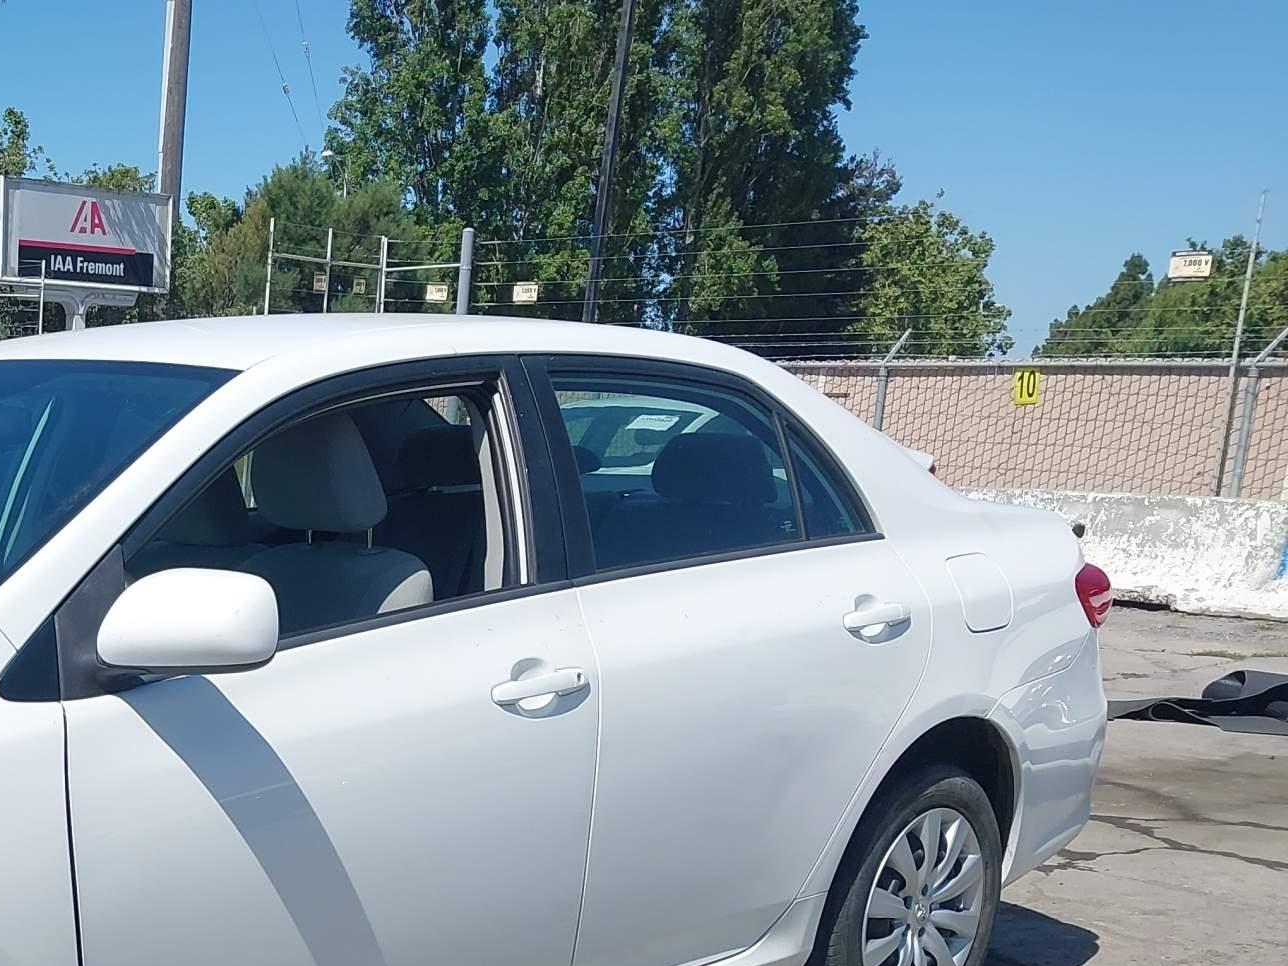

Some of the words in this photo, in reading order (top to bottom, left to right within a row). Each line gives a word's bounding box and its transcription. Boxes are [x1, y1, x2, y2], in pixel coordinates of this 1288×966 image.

[50, 254, 74, 273] IAA
[77, 257, 125, 276] Fremont
[1017, 369, 1037, 399] 10
